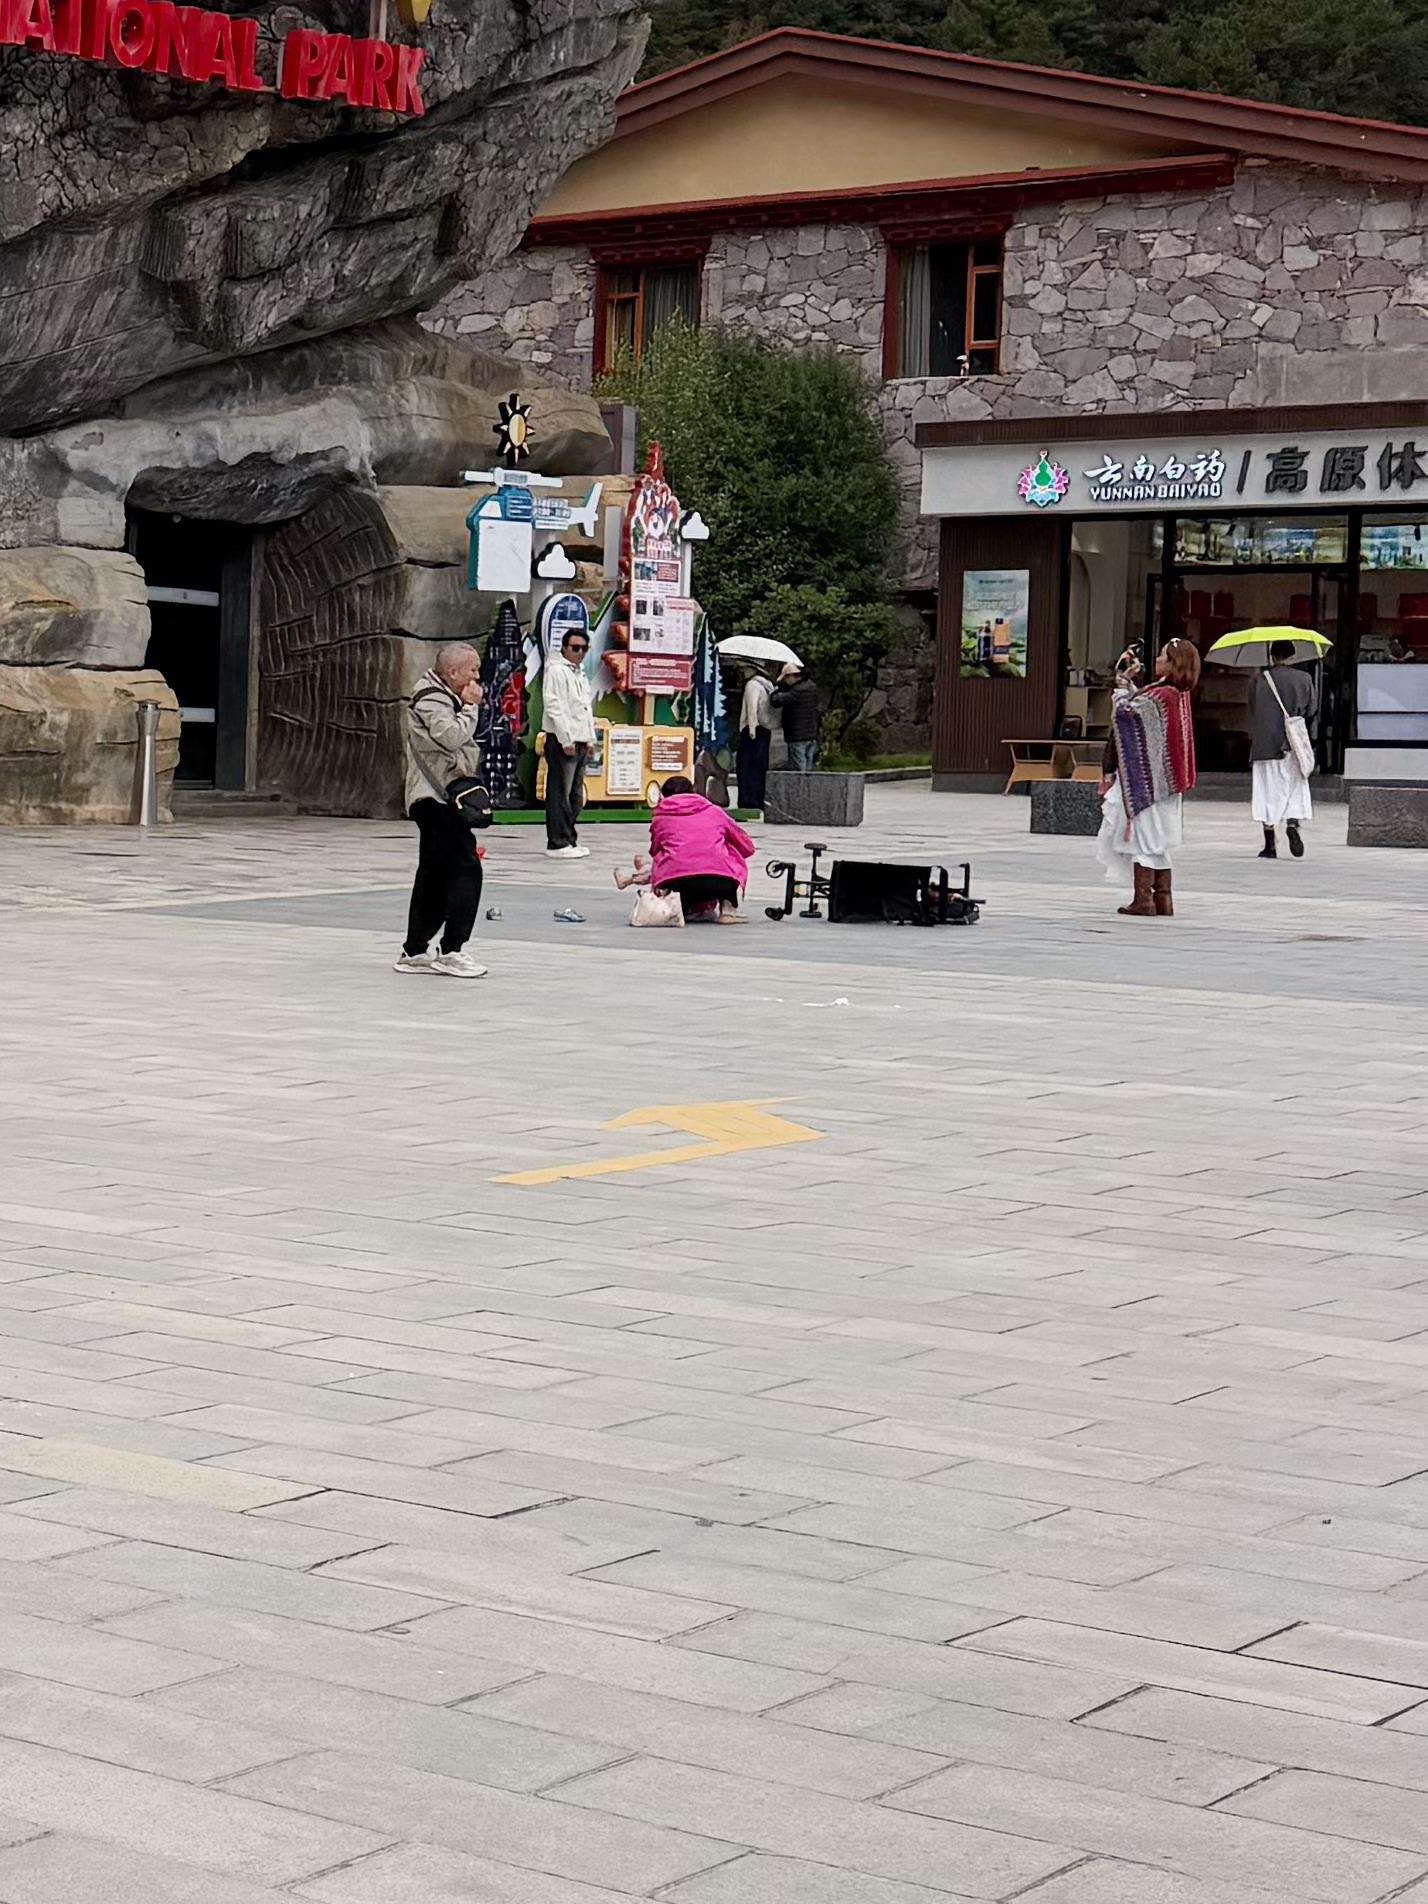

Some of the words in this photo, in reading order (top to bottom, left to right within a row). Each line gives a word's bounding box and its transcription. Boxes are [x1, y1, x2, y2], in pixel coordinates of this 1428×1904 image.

[282, 28, 427, 115] PARK
[1083, 448, 1226, 485] 云南白药
[1089, 483, 1156, 501] YUNNAN
[1158, 481, 1223, 499] BAIYAO
